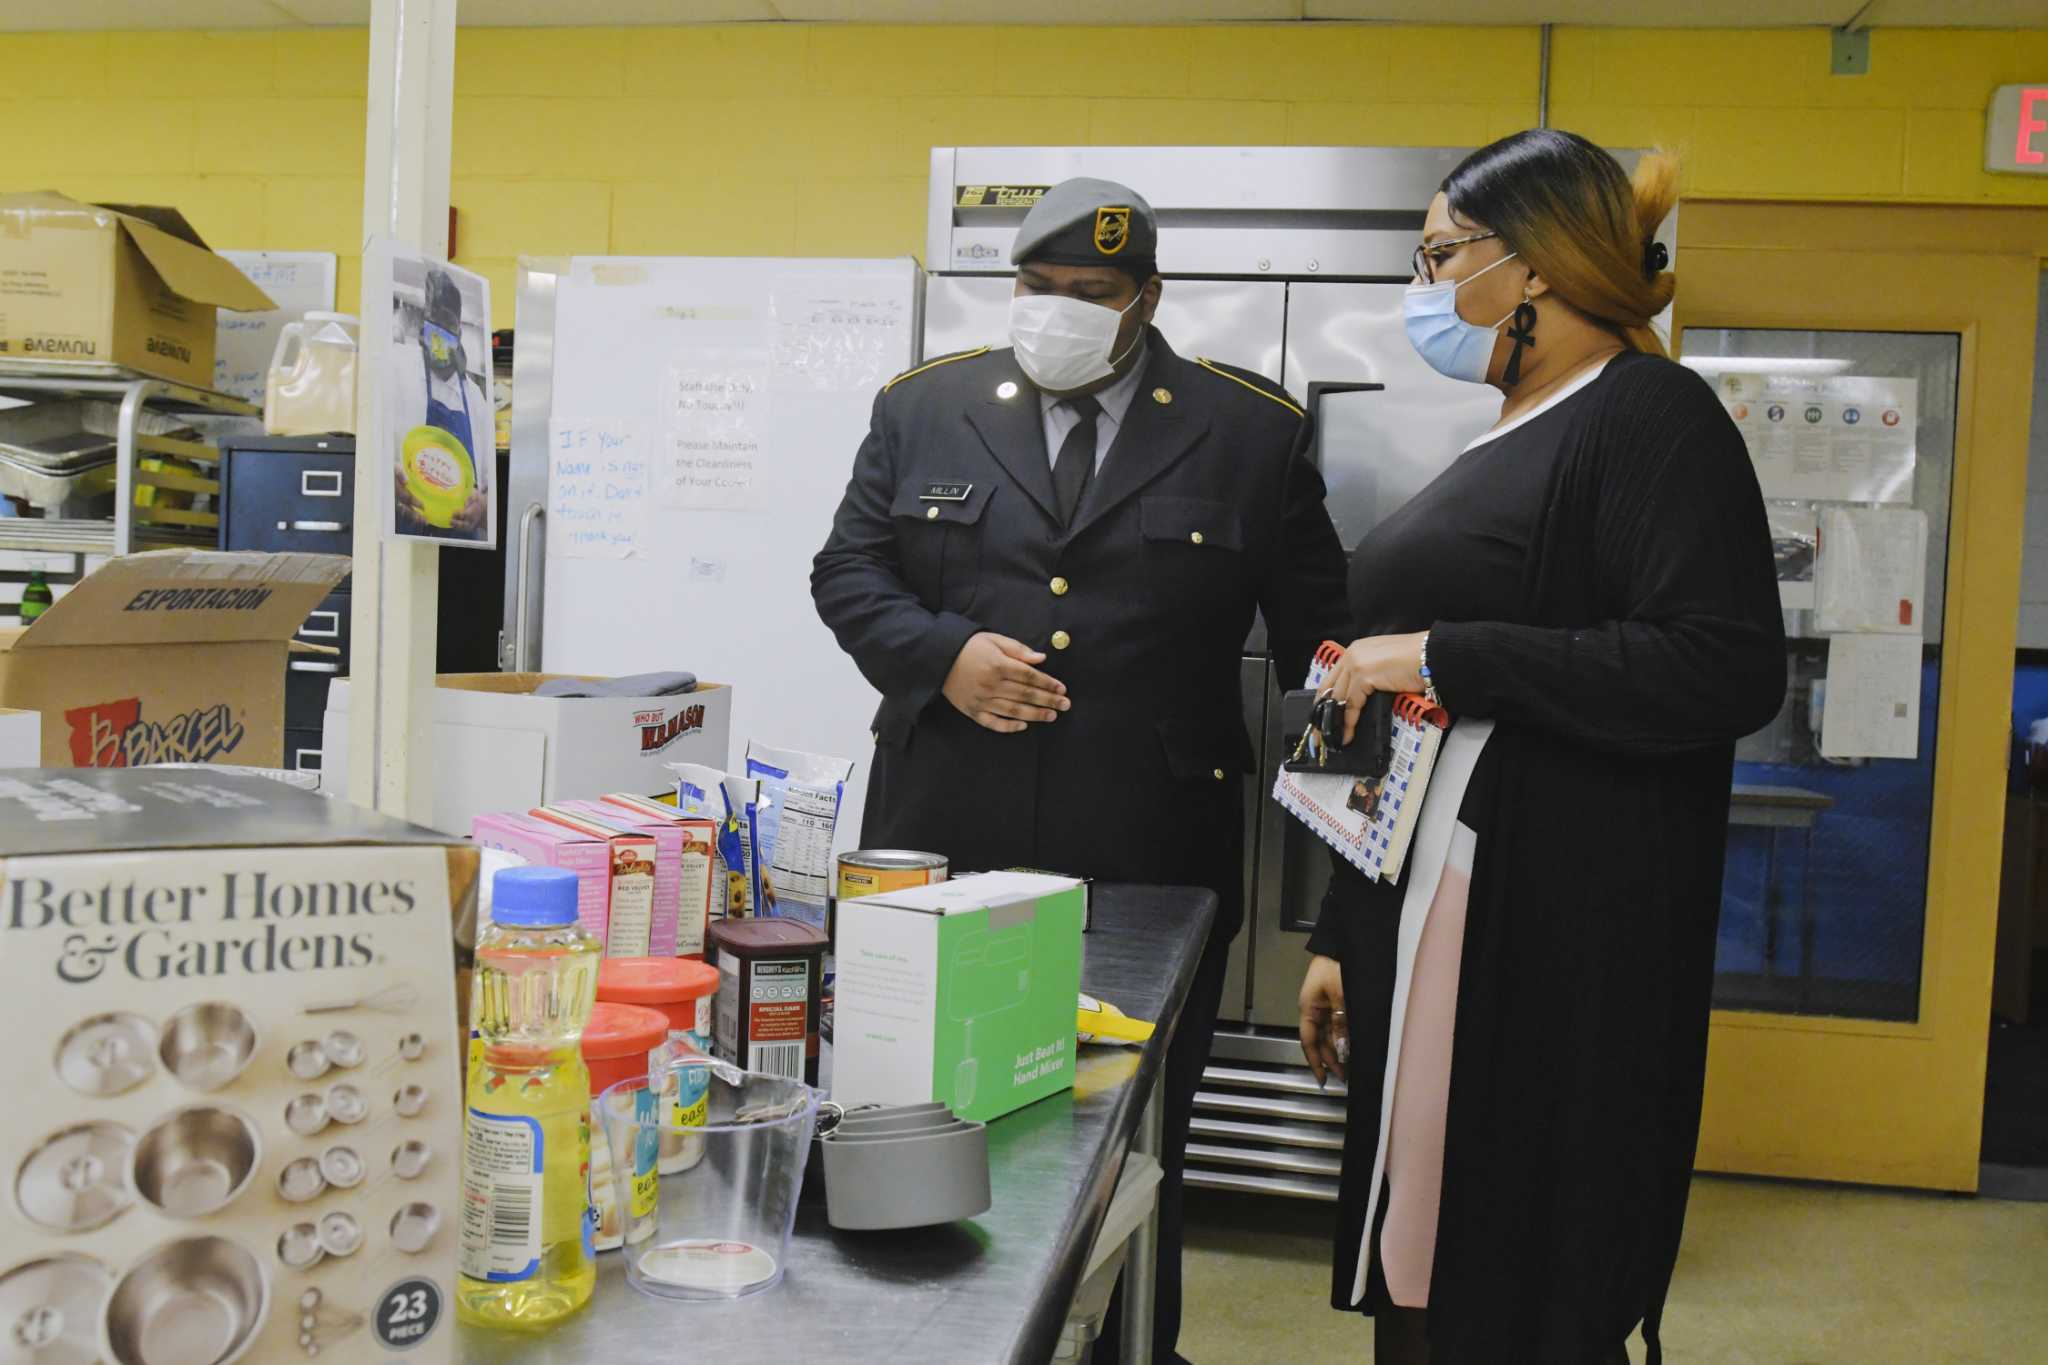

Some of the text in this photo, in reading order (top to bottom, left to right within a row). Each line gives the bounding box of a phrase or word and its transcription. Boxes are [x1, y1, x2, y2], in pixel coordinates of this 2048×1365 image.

[25, 336, 96, 356] nuwave
[145, 336, 192, 364] nuwave
[676, 439, 759, 452] Please Maintain
[675, 459, 753, 471] the Cleanliness
[674, 477, 688, 488] of
[689, 478, 712, 489] Your
[123, 583, 272, 611] EXPORTACIÓN
[633, 711, 664, 724] WHO BUT
[122, 703, 244, 768] BARCEL
[6, 871, 417, 930] Better Homes
[56, 924, 375, 984] & Gardens
[1014, 1052, 1033, 1070] Just
[1035, 1043, 1055, 1062] Beat
[1014, 1056, 1065, 1087] Hand Mixer
[388, 1289, 427, 1324] 23
